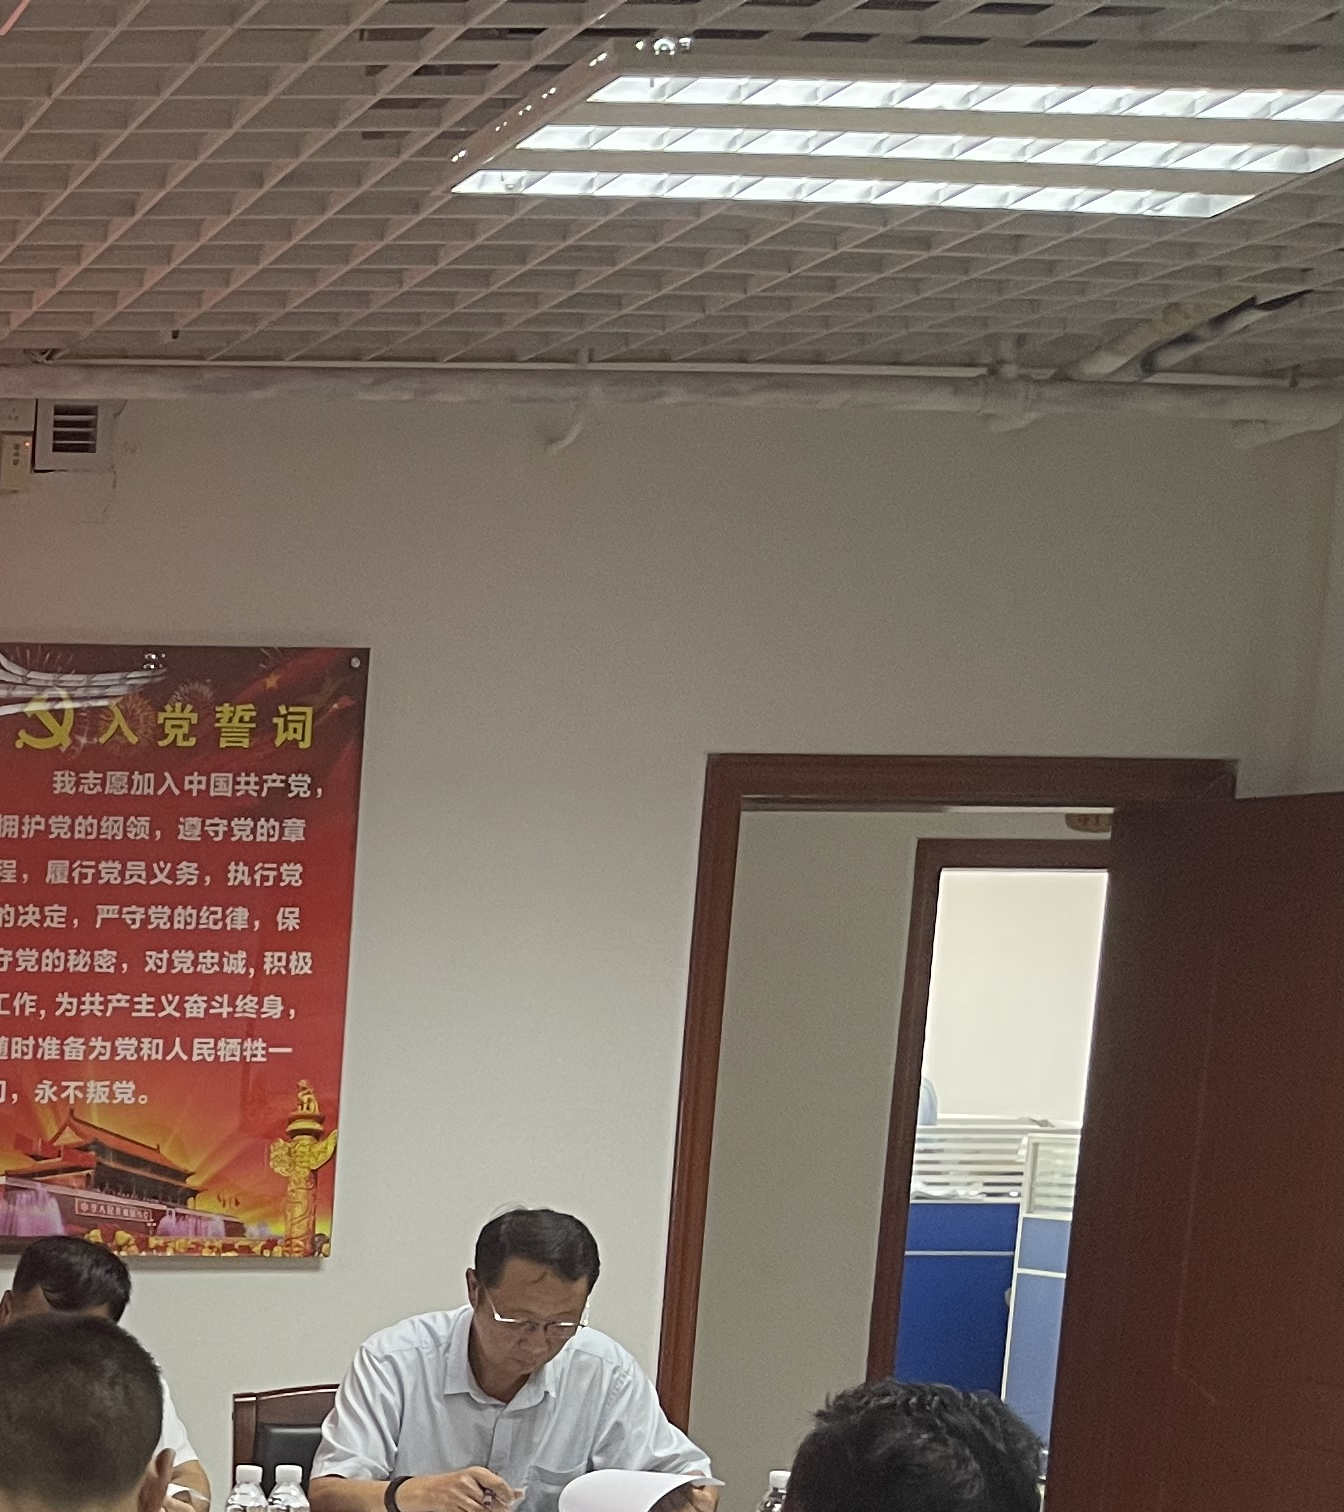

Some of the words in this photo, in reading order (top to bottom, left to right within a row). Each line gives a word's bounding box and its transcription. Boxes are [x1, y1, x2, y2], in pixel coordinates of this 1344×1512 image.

[99, 699, 313, 749] 入党誓词
[52, 770, 324, 799] 我志愿加入中国共产党，
